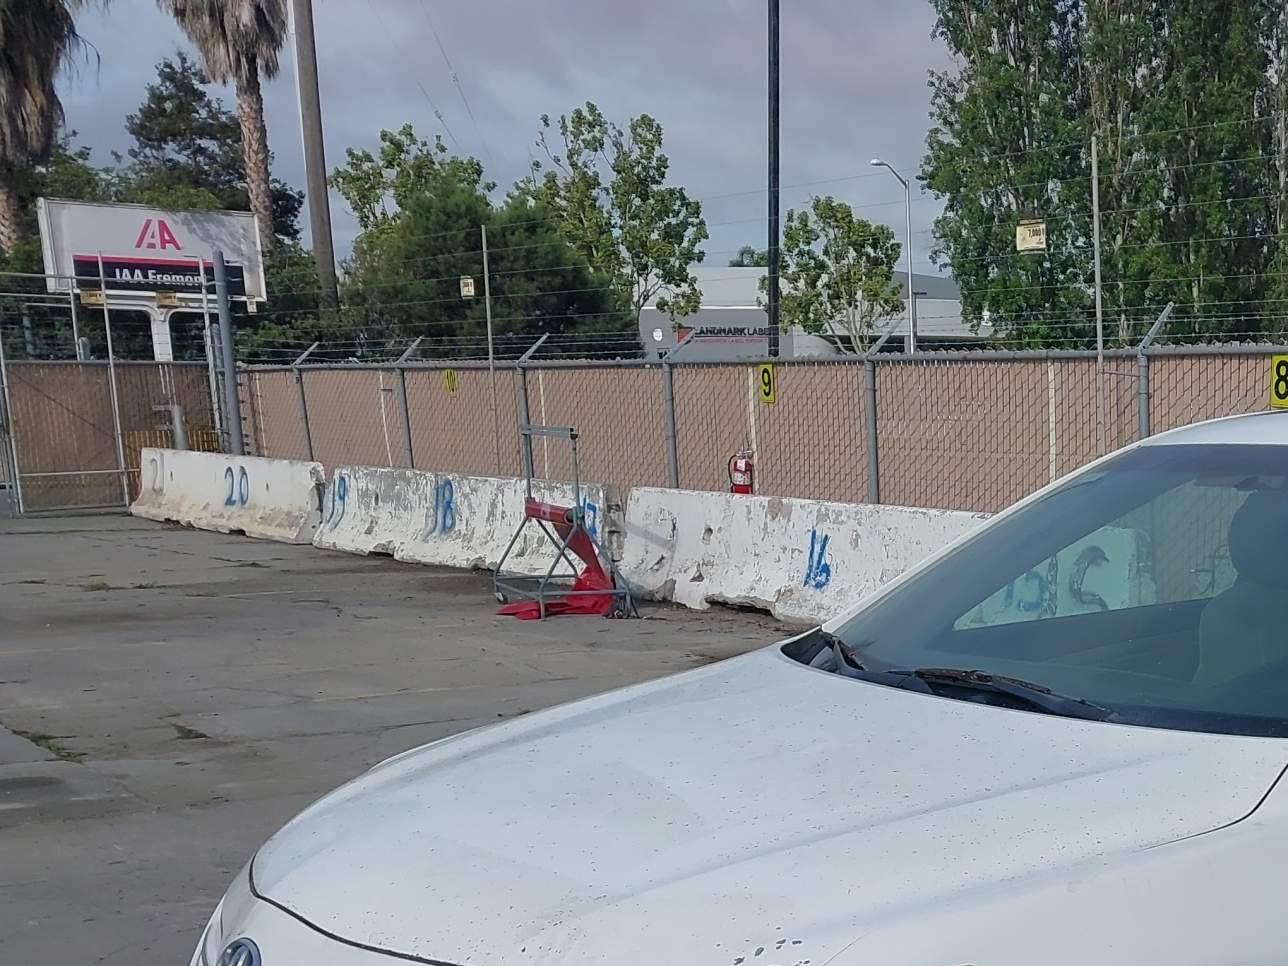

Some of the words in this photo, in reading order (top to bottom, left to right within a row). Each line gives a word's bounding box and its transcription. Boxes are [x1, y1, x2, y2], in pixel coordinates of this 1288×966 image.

[114, 268, 144, 283] IAA
[147, 270, 203, 286] Fremon
[747, 327, 769, 336] LABE
[761, 367, 772, 397] 9
[224, 465, 249, 506] 20
[327, 475, 346, 532] 19
[430, 478, 456, 536] 18
[803, 527, 832, 592] 16
